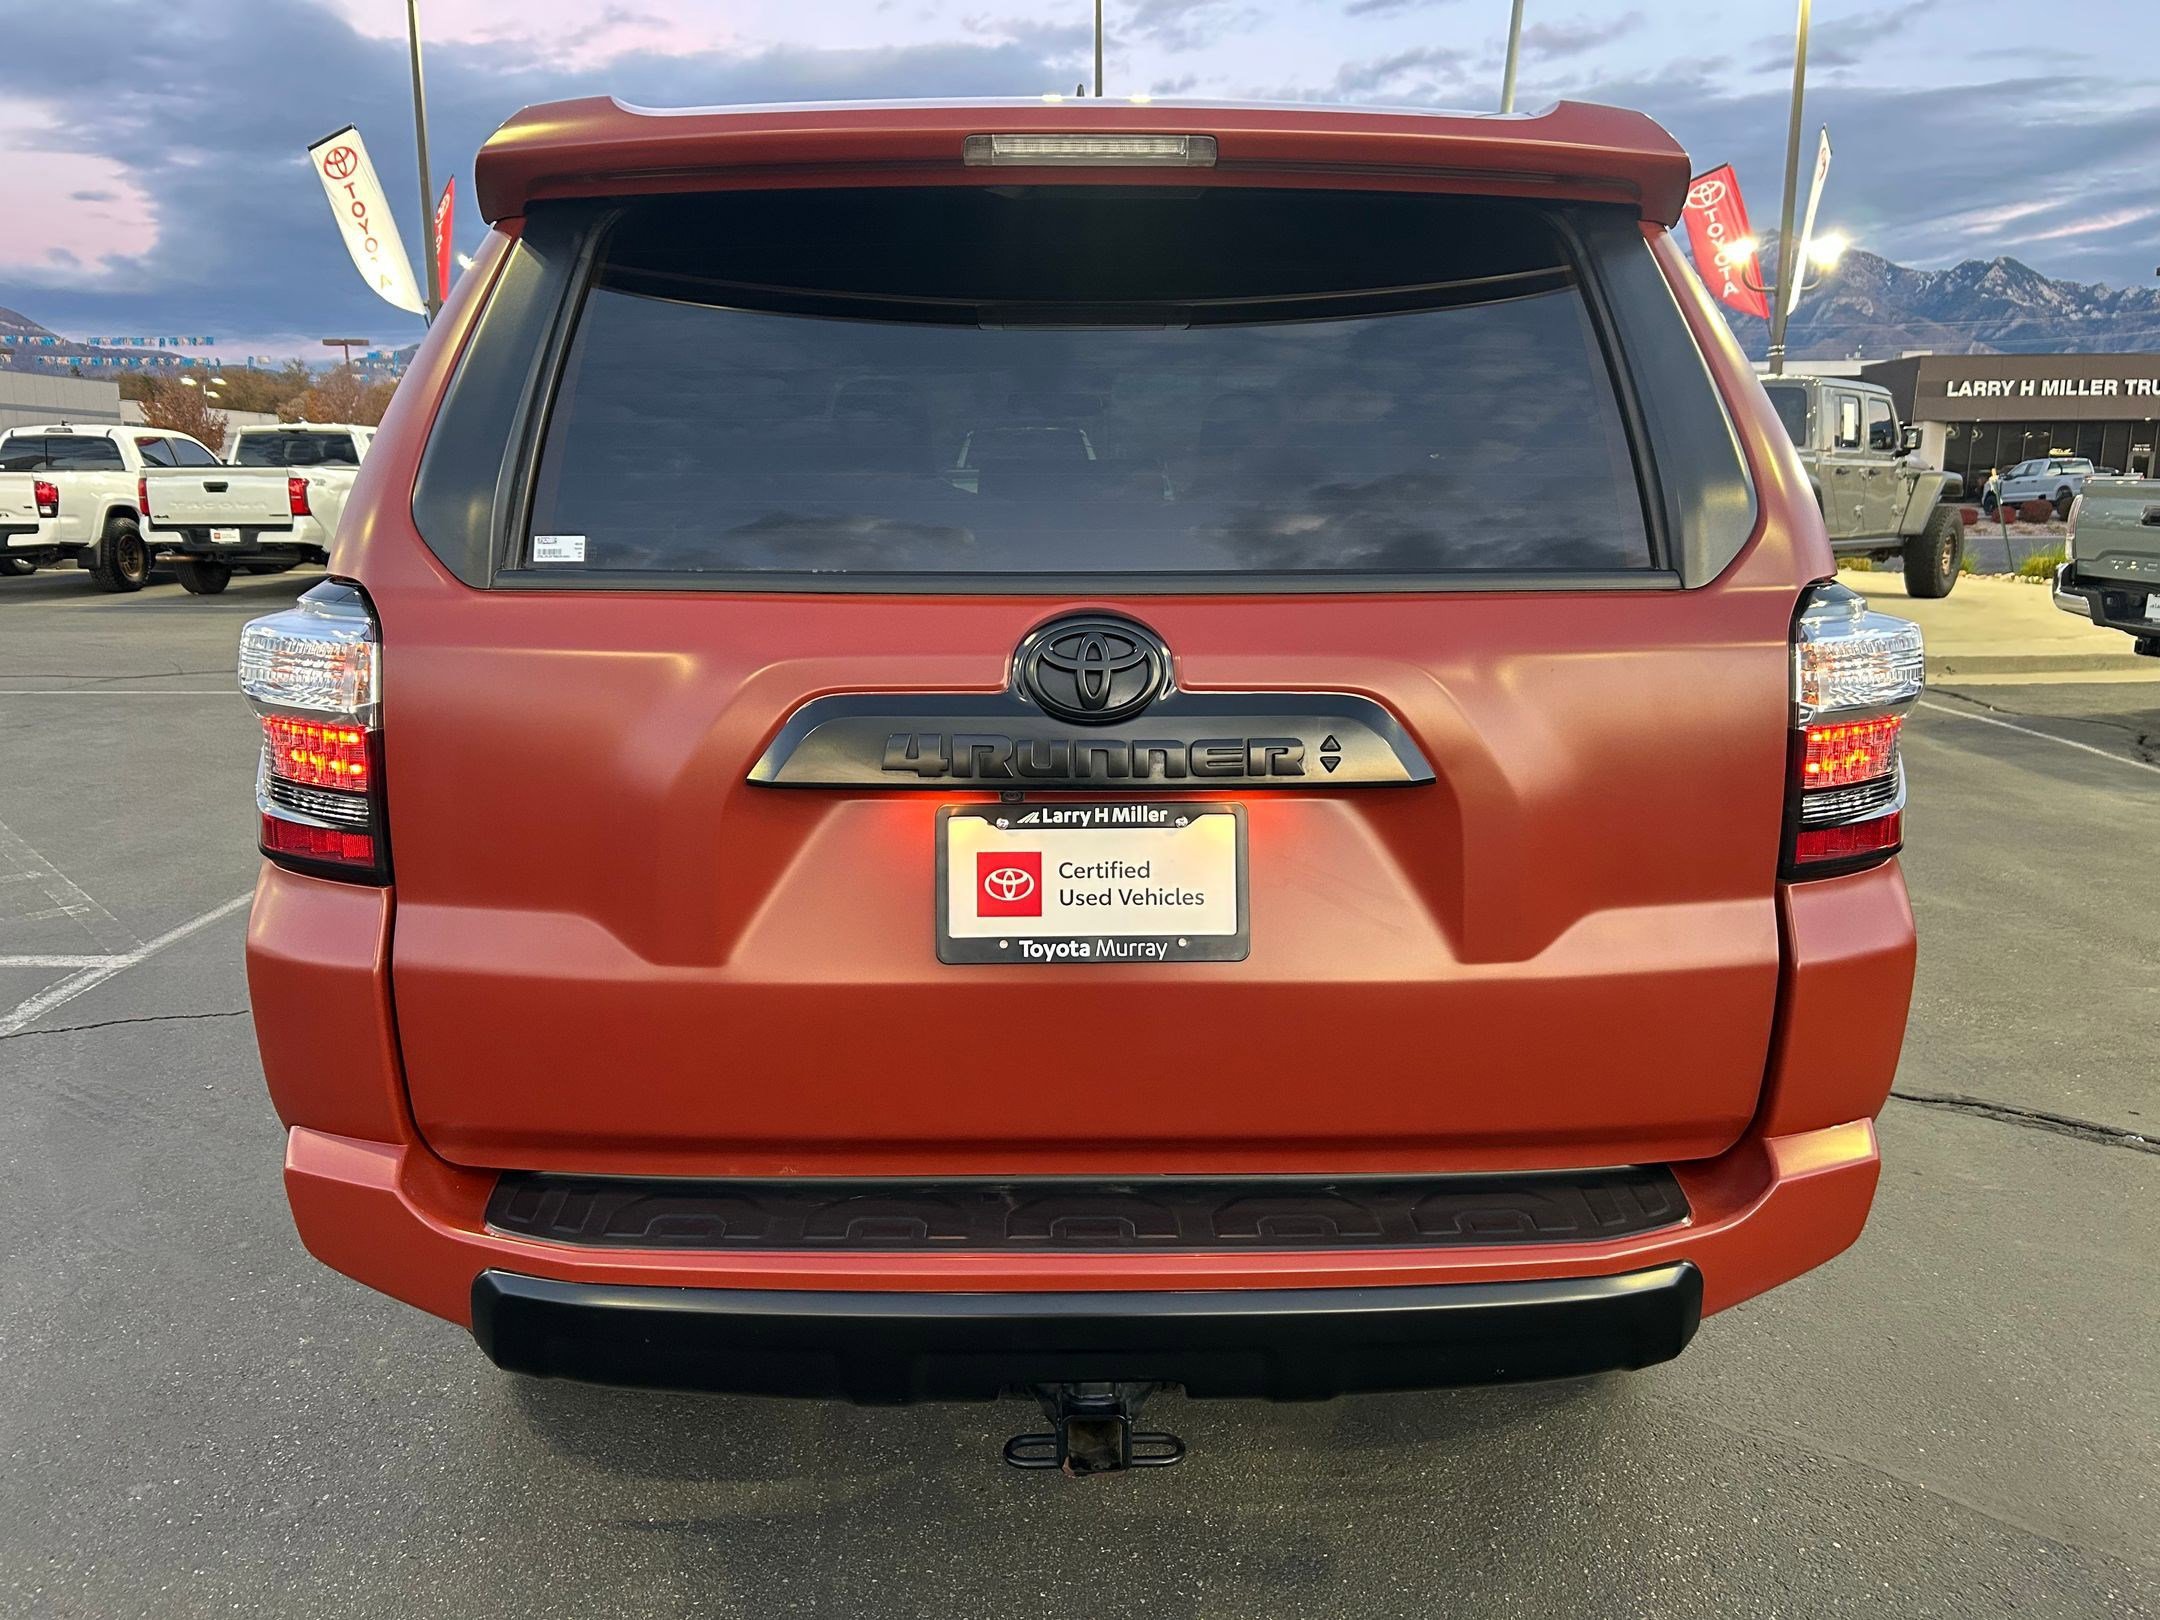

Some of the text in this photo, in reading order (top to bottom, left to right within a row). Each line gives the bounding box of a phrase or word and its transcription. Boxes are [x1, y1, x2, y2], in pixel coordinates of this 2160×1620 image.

[344, 182, 393, 289] TOYOA
[1946, 380, 2015, 397] LARRY
[2020, 380, 2035, 397] H
[2041, 379, 2118, 397] MILLER
[1042, 805, 1168, 827] Larry H Miller
[1058, 860, 1151, 880] Certified
[1059, 887, 1205, 907] Used Vehicles
[1019, 938, 1168, 962] Toyota Murray
